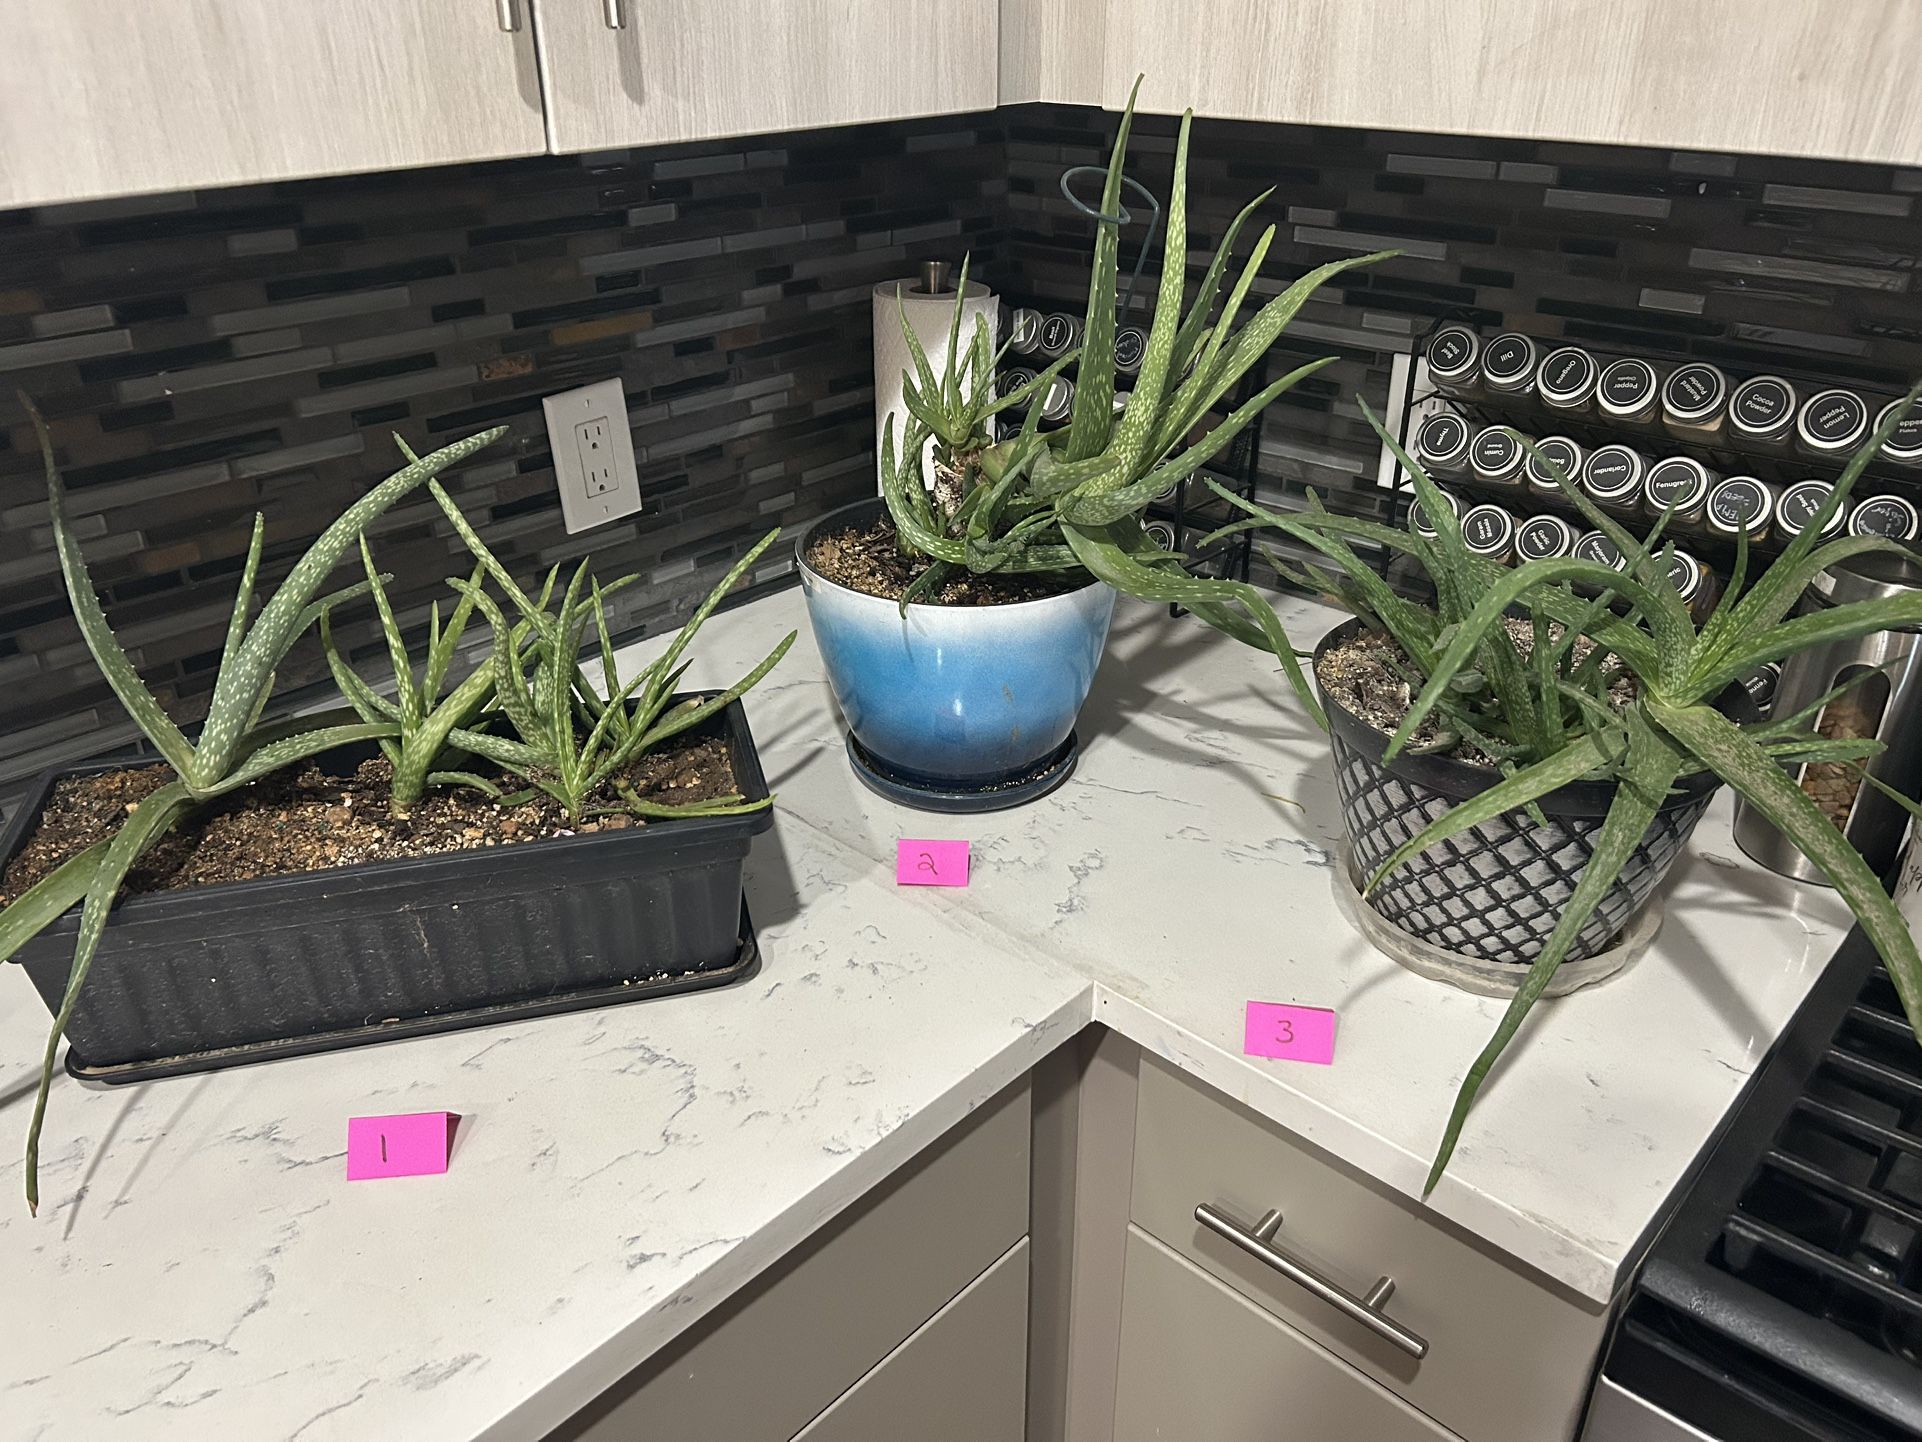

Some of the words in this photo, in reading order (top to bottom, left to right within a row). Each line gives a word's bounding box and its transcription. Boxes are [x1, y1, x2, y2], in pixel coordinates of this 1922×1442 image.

[1441, 347, 1453, 359] Beef
[1447, 341, 1460, 355] Stock
[1500, 350, 1513, 361] Dill
[1556, 360, 1577, 384] Oregano
[1613, 381, 1639, 390] Pepper
[1680, 379, 1701, 401] Mustard
[1688, 375, 1708, 396] Powder
[1745, 400, 1772, 414] Powder
[1752, 393, 1775, 407] Cocoa
[1819, 405, 1846, 424] Pepper
[1823, 412, 1851, 429] Lemon
[1899, 419, 1922, 427] epper
[1436, 427, 1450, 446] Thyme
[1484, 448, 1504, 456] Cumin
[1593, 464, 1627, 475] Coriander
[1796, 493, 1808, 507] Seed
[1476, 520, 1486, 540] Garam
[1483, 518, 1493, 538] Masala
[1530, 531, 1546, 551] Powder
[1537, 529, 1551, 545] Garlic
[1591, 540, 1610, 565] Marjoram
[1748, 678, 1768, 694] Fenne
[918, 853, 938, 875] 2
[1276, 1020, 1294, 1043] 3
[381, 1133, 387, 1163] 1
